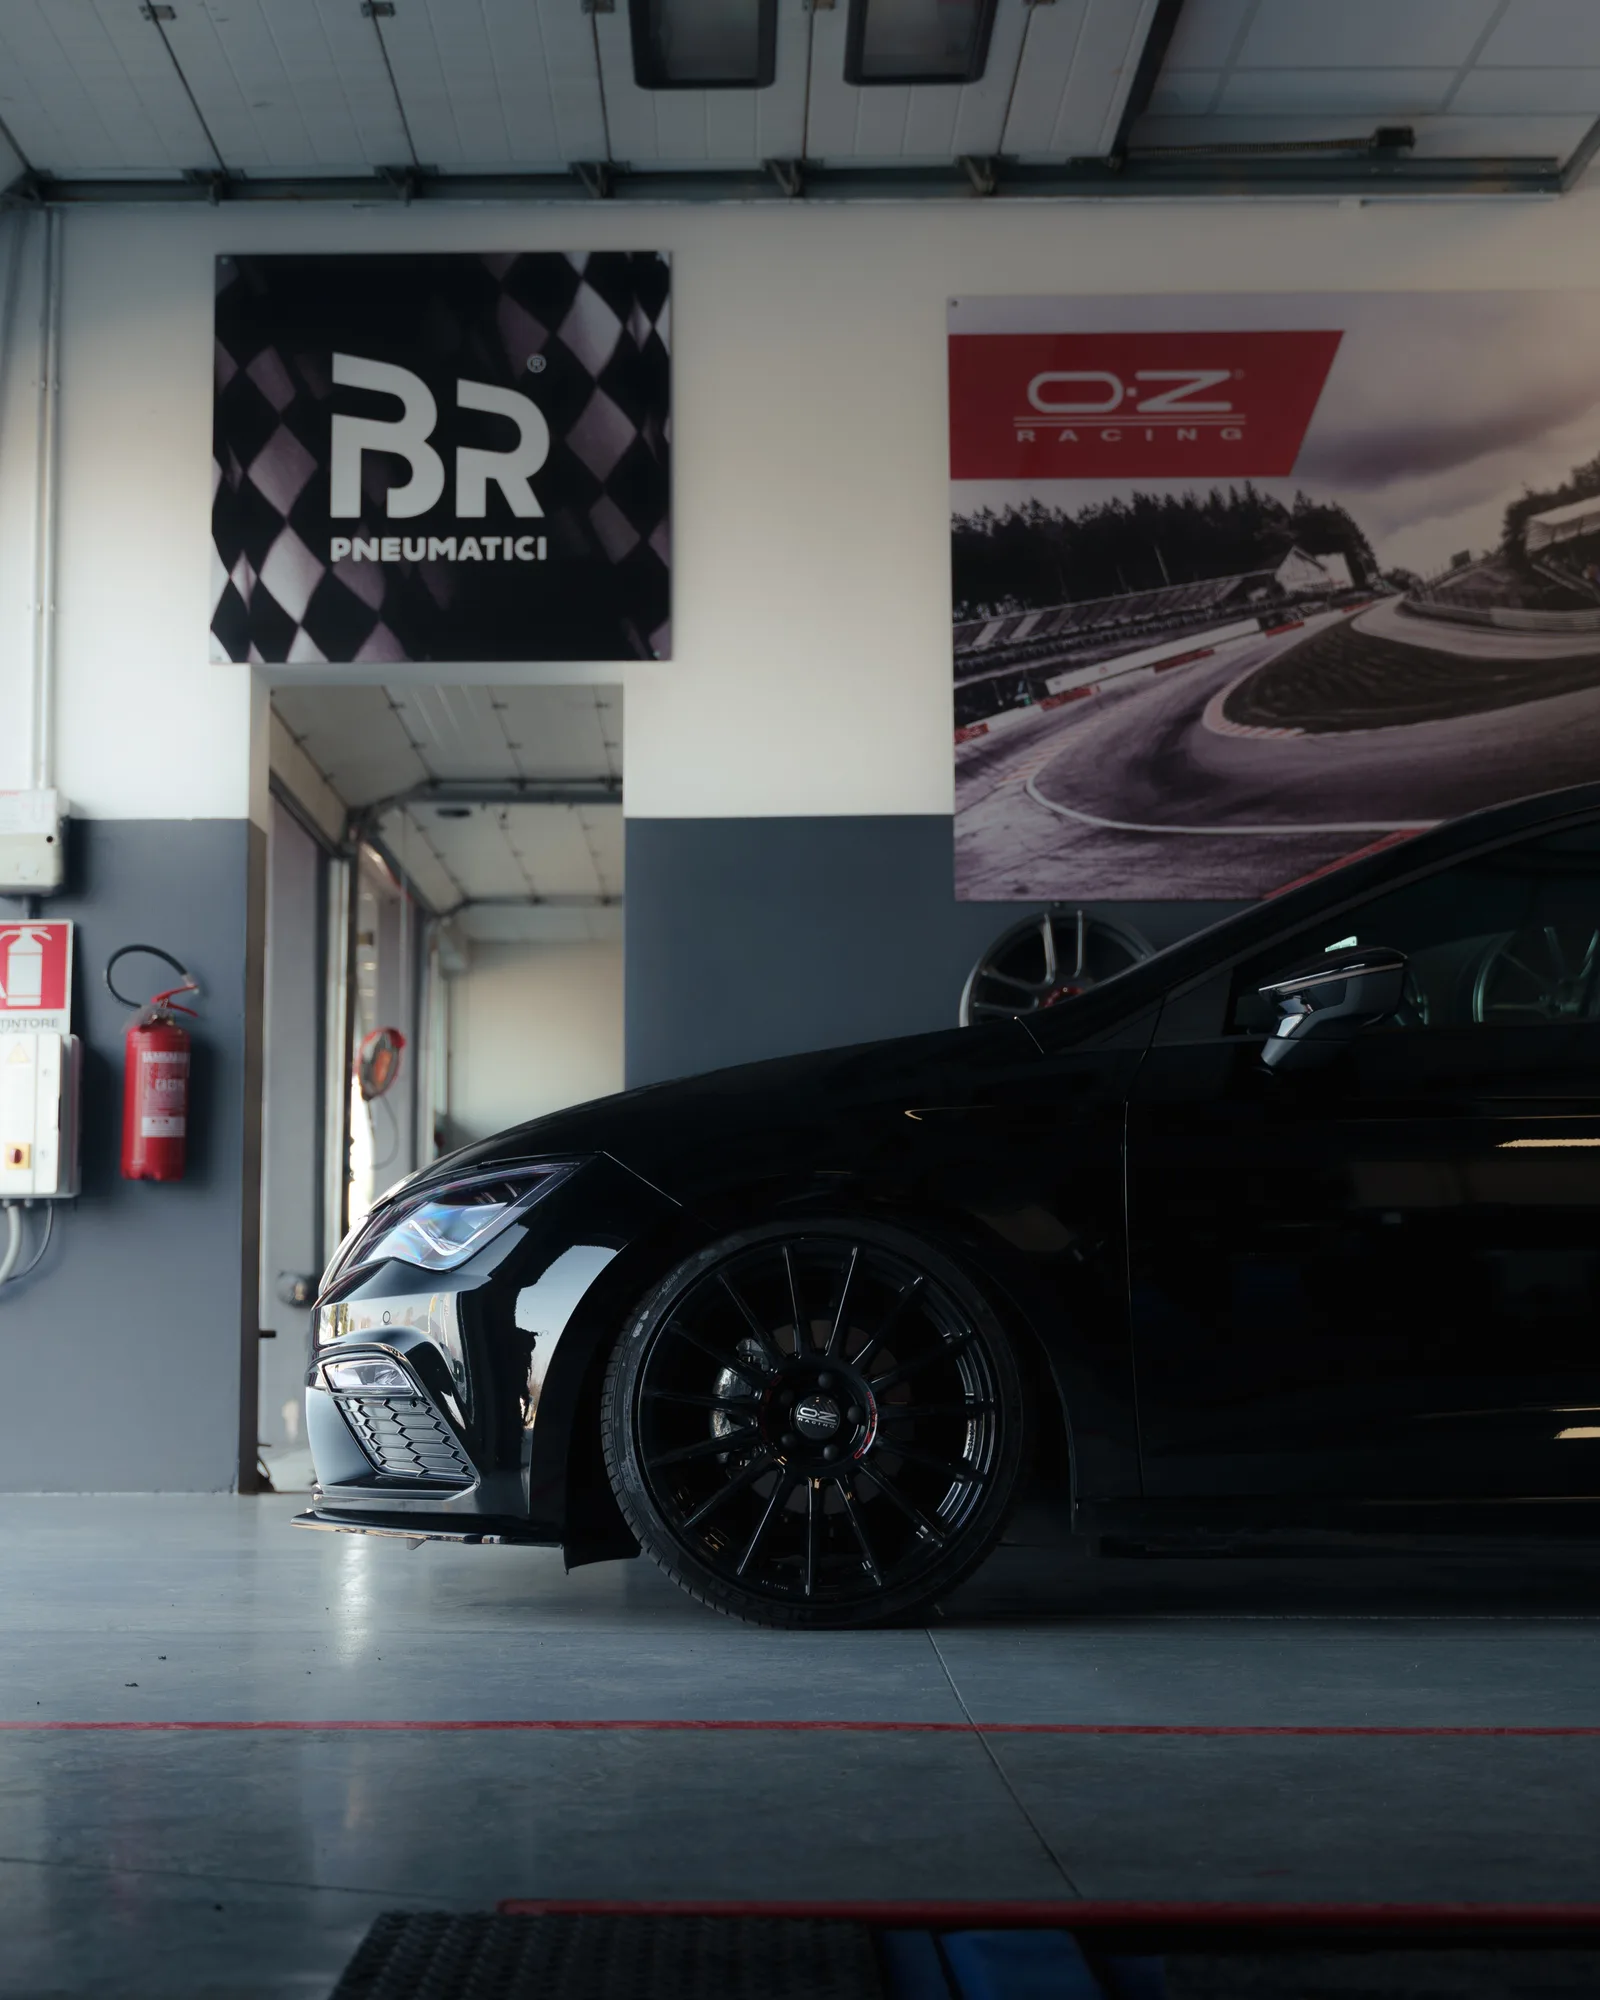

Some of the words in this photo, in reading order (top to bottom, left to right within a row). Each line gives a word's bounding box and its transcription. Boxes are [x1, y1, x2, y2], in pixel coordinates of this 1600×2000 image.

[330, 352, 549, 518] BR
[1016, 428, 1242, 442] RACING
[330, 536, 547, 562] PNEUMATICI
[798, 1417, 835, 1429] RACING
